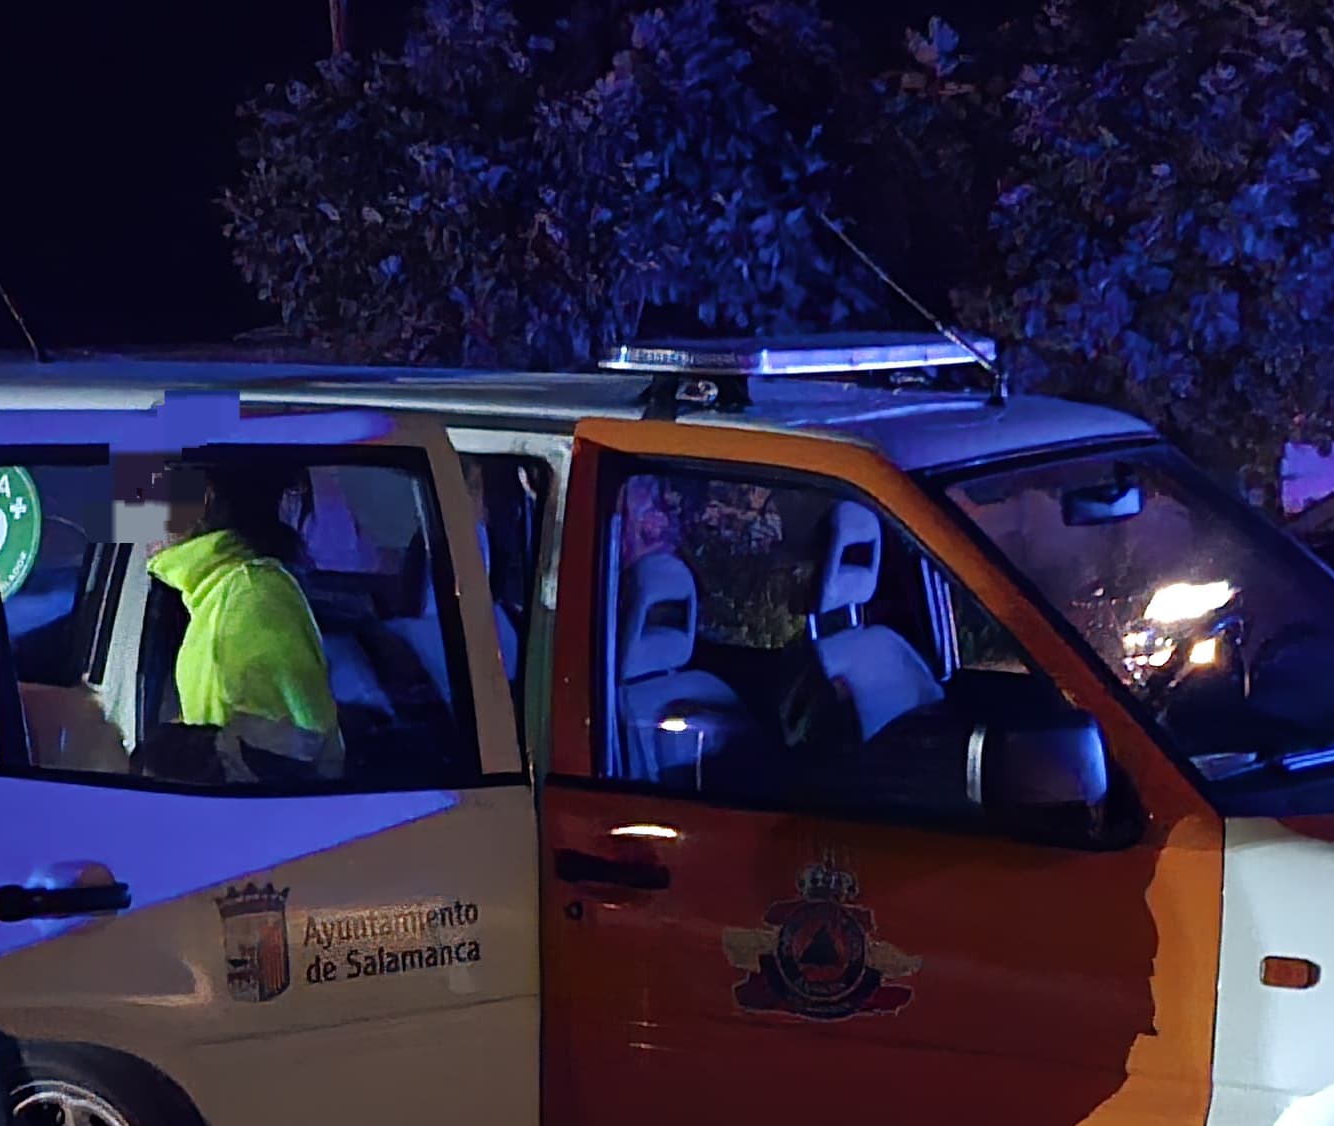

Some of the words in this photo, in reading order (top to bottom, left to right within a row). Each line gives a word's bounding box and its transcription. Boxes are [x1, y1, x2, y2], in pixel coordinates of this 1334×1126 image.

[304, 900, 478, 950] Ayuntamiento
[307, 954, 336, 984] de
[347, 941, 481, 978] Salamanca
